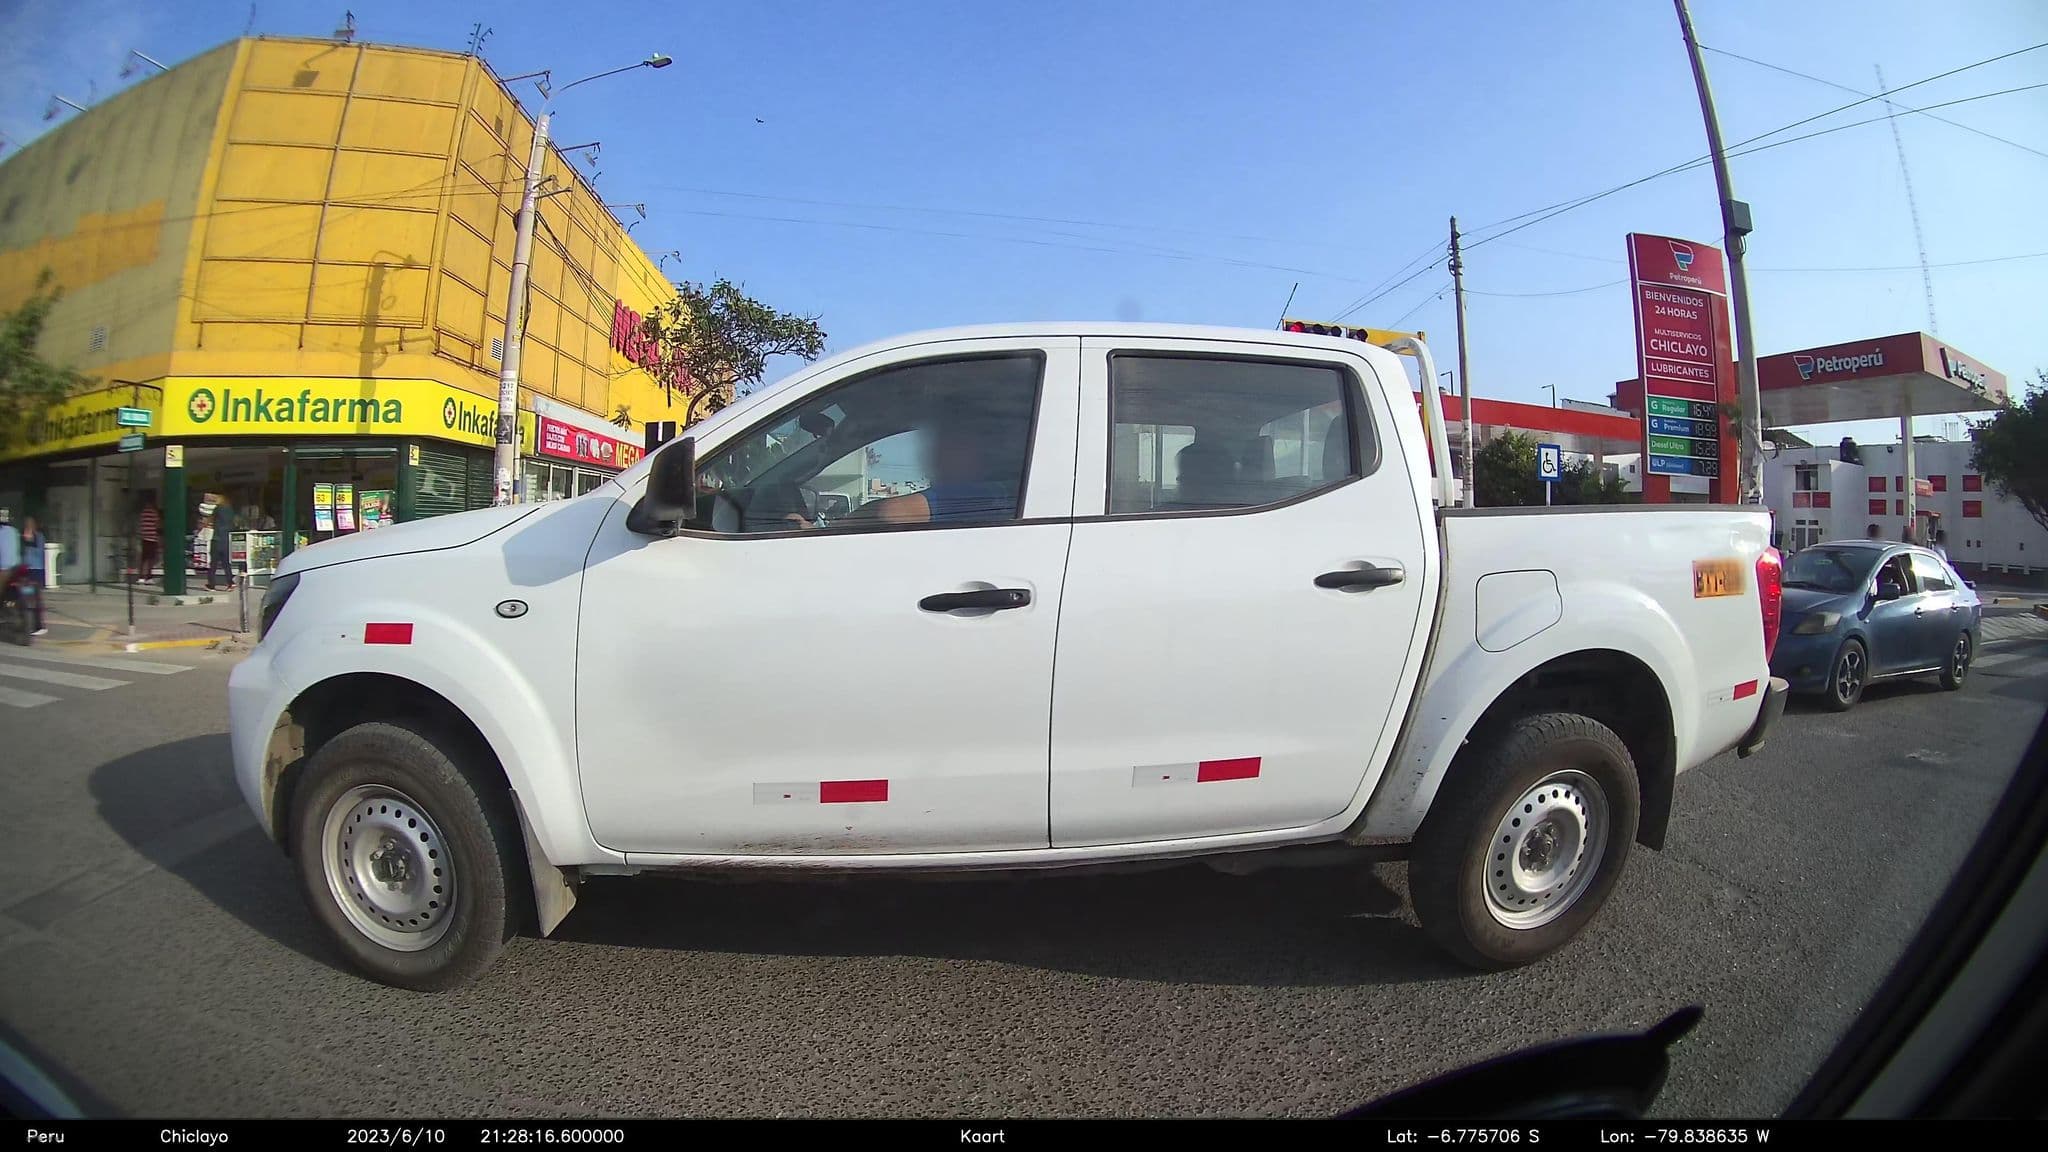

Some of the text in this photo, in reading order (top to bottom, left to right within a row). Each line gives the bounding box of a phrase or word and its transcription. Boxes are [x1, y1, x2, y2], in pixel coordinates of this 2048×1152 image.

[1645, 290, 1704, 307] BIENVENIDOS
[1654, 305, 1698, 320] 24 HORAS
[1654, 328, 1702, 341] MULTISERVICIOS
[1650, 338, 1708, 357] CHICLAYO
[1816, 347, 1884, 374] Petroperú
[1651, 362, 1710, 379] LUBRICANTES
[221, 388, 402, 424] Inkafarma
[1650, 400, 1658, 410] G
[1661, 404, 1686, 414] Regular
[1651, 419, 1658, 429] G
[1663, 423, 1690, 433] Premium
[615, 441, 641, 469] MEGA
